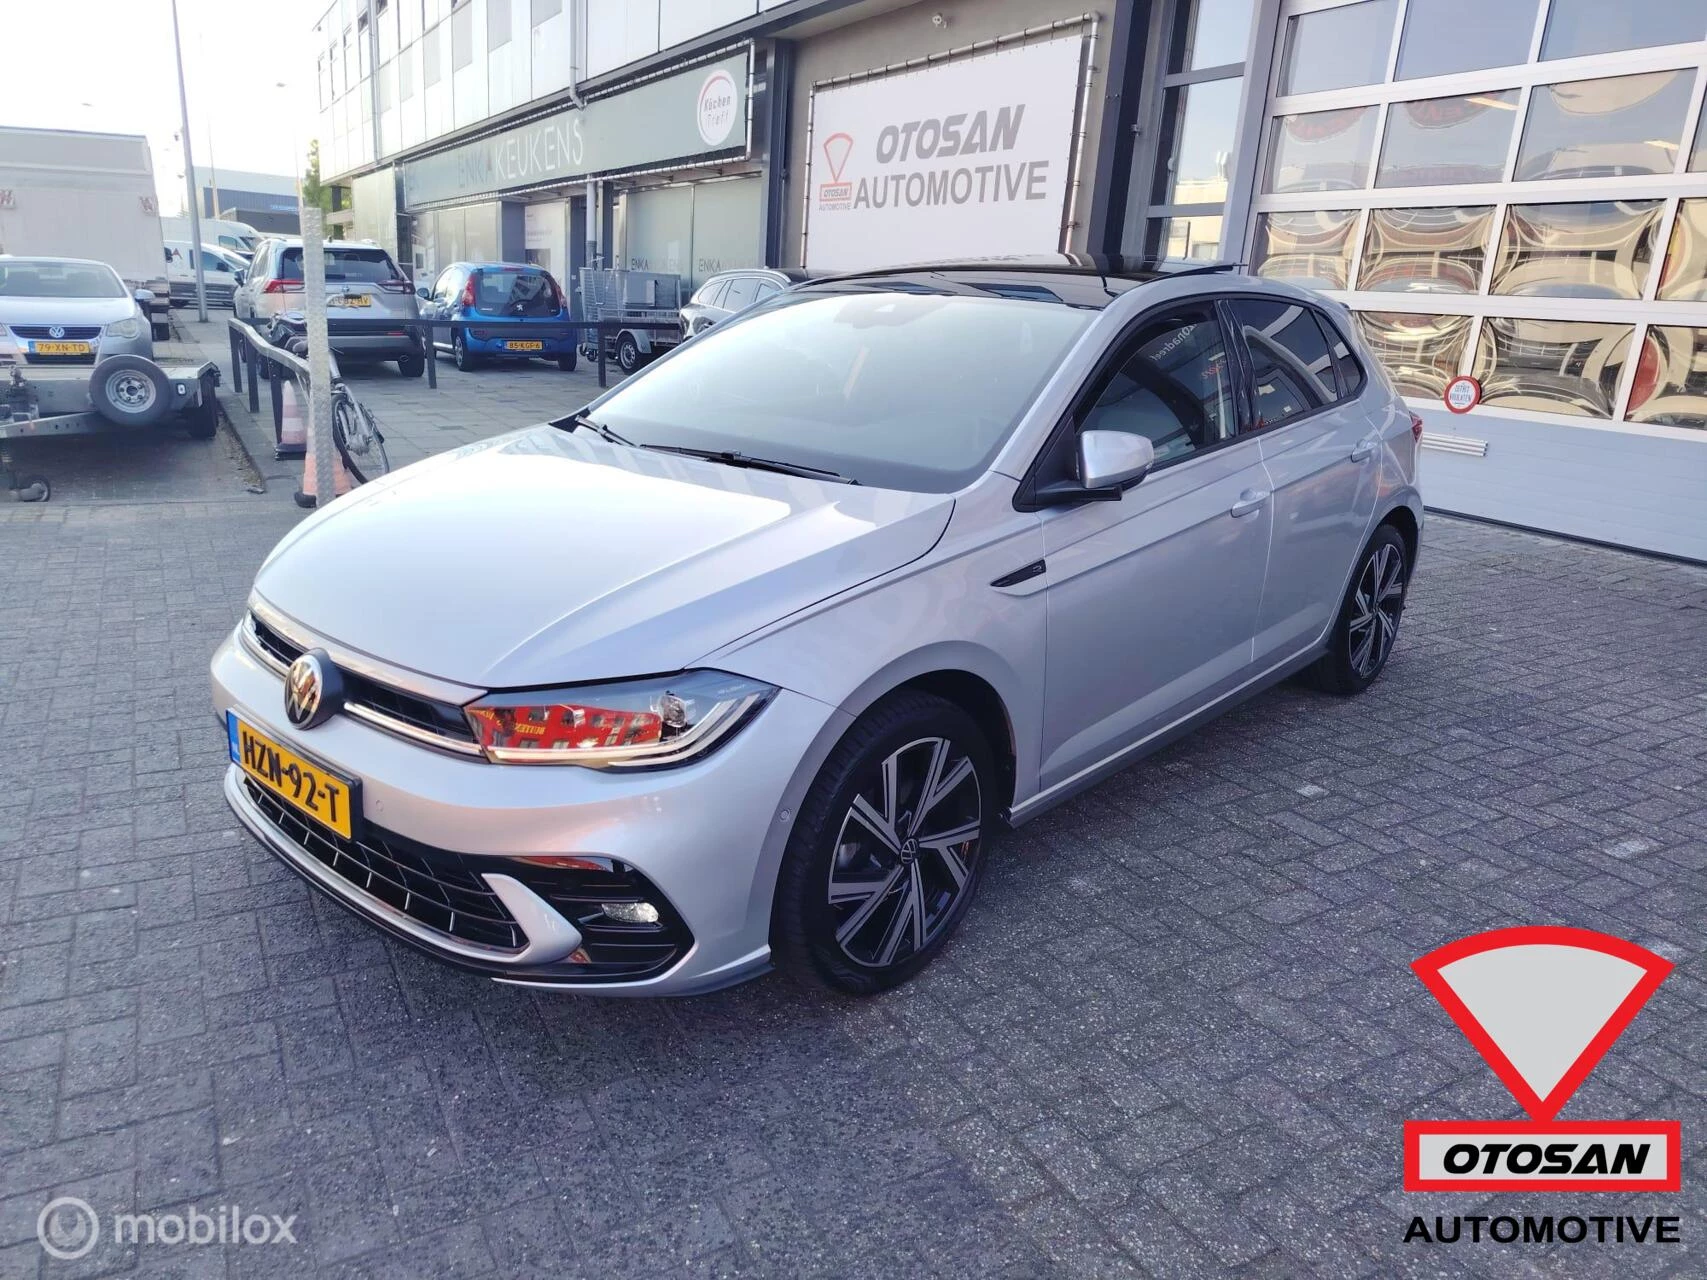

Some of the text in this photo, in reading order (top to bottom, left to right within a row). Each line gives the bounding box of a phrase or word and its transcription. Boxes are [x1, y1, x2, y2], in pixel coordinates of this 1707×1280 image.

[494, 117, 584, 182] KEUKENS
[875, 103, 1026, 165] OTOSAN
[853, 160, 1050, 210] AUTOMOTIVE
[631, 257, 650, 271] ENKA
[698, 257, 721, 272] ENKA
[242, 731, 340, 823] HZN-92-T
